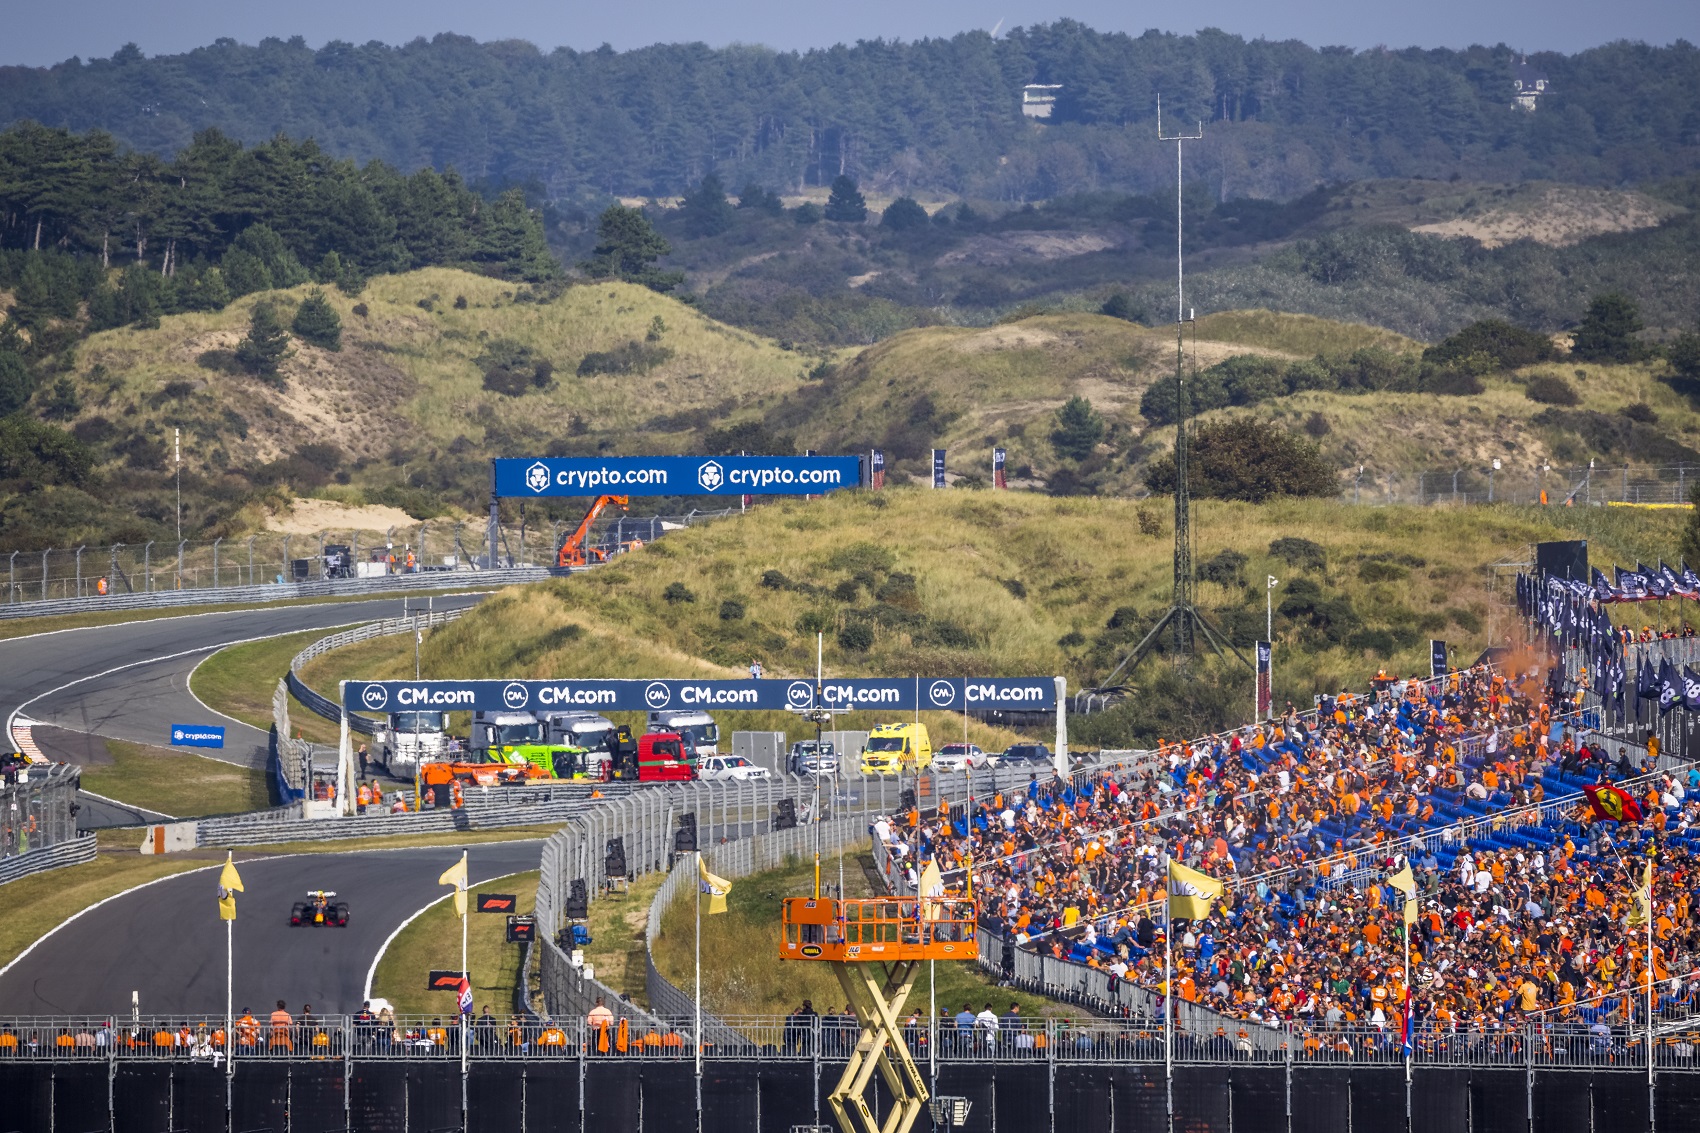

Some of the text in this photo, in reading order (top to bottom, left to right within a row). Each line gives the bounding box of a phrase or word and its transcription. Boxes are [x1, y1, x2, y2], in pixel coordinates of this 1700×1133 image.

[556, 466, 668, 488] crypto.com
[729, 466, 841, 487] crypto.com
[397, 687, 475, 704] CM.com
[537, 687, 616, 704] CM.com
[679, 686, 758, 704] CM.com
[822, 685, 900, 703] CM.com
[965, 684, 1043, 702] CM.com
